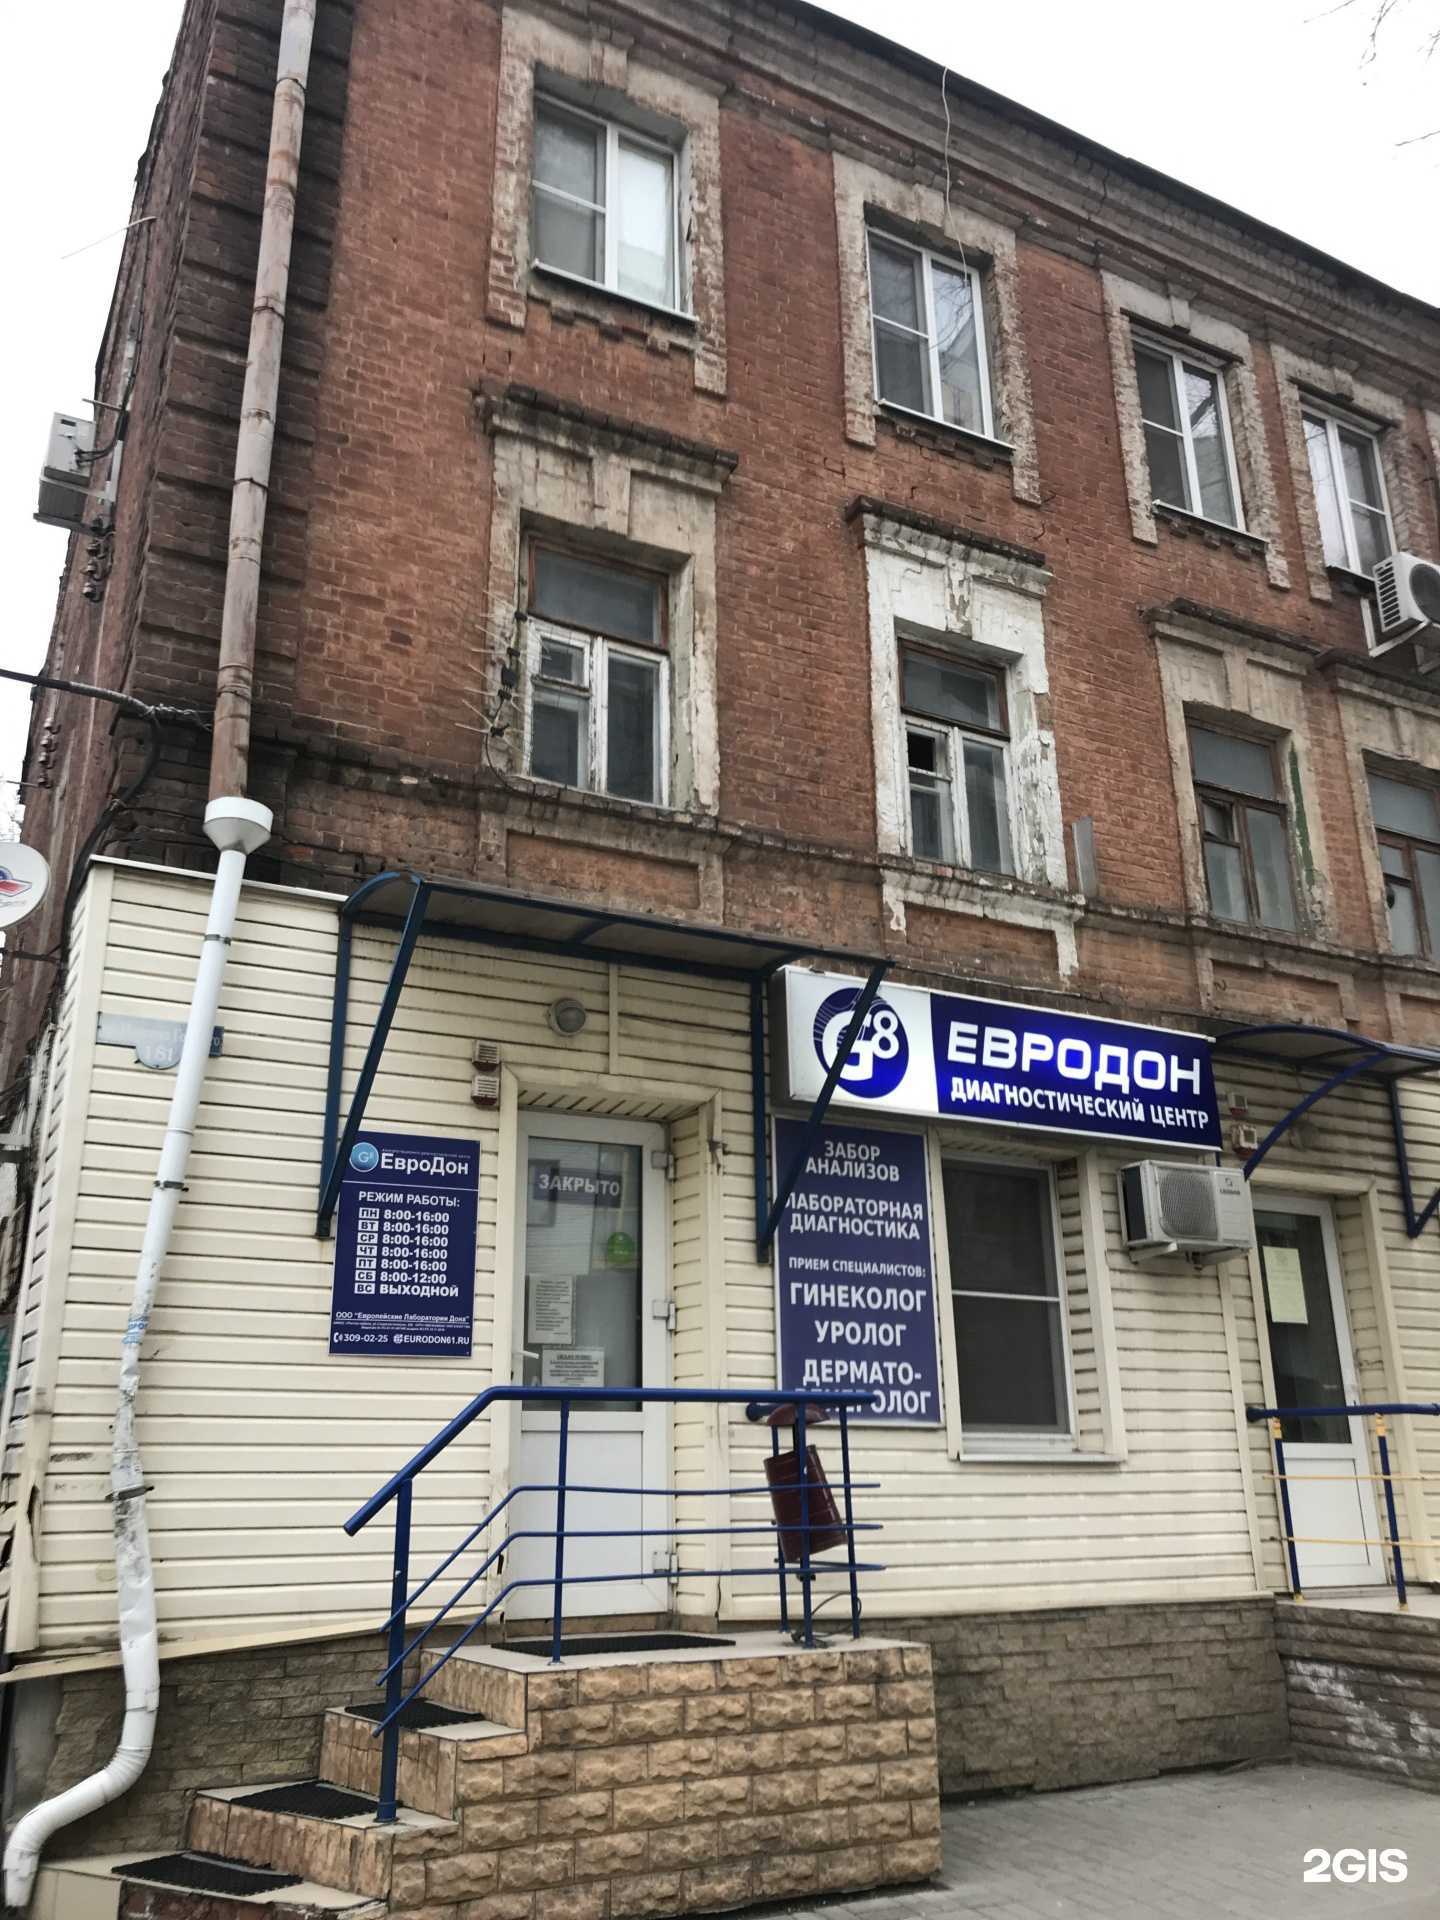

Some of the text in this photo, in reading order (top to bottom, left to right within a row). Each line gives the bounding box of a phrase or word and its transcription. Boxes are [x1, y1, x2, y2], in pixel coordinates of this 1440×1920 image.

[947, 1020, 1201, 1095] ЕВРОДОН
[950, 1076, 1209, 1130] ДИАГНОСТИЧЕСКИЙ ЦЕНТР
[824, 1140, 881, 1161] ЗАБОР
[381, 1153, 469, 1176] ЕвроДон
[805, 1156, 900, 1182] АНАЛИЗОВ
[538, 1173, 620, 1196] ЗАКРЫТО
[358, 1190, 461, 1207] РЕЖИМ РАБОТЫ:
[785, 1192, 924, 1221] ЛАБОРАТОРНАЯ
[360, 1208, 450, 1223] ПН 8:00-16:00
[790, 1212, 921, 1240] ДИАГНОСТИКА
[360, 1221, 449, 1235] ВТ 8:00-16:00
[359, 1233, 449, 1247] СР 8:00-16:00
[359, 1246, 448, 1259] ЧТ 8:00-16:00
[358, 1259, 448, 1272] ПТ 8:00-16:00
[788, 1256, 926, 1278] ПРИЕМ СПЕЦИАЛИСТОВ:
[357, 1271, 447, 1284] СБ 8:00-12:00
[356, 1283, 459, 1298] ВС ВЫХОДНОЙ
[790, 1282, 927, 1312] ГИНЕКОЛОГ
[335, 1311, 353, 1320] ООО
[343, 1333, 470, 1345] 309-02-25 EURODON61.RU
[814, 1320, 907, 1347] УРОЛОГ
[802, 1359, 922, 1387] ДЕРМАТО-
